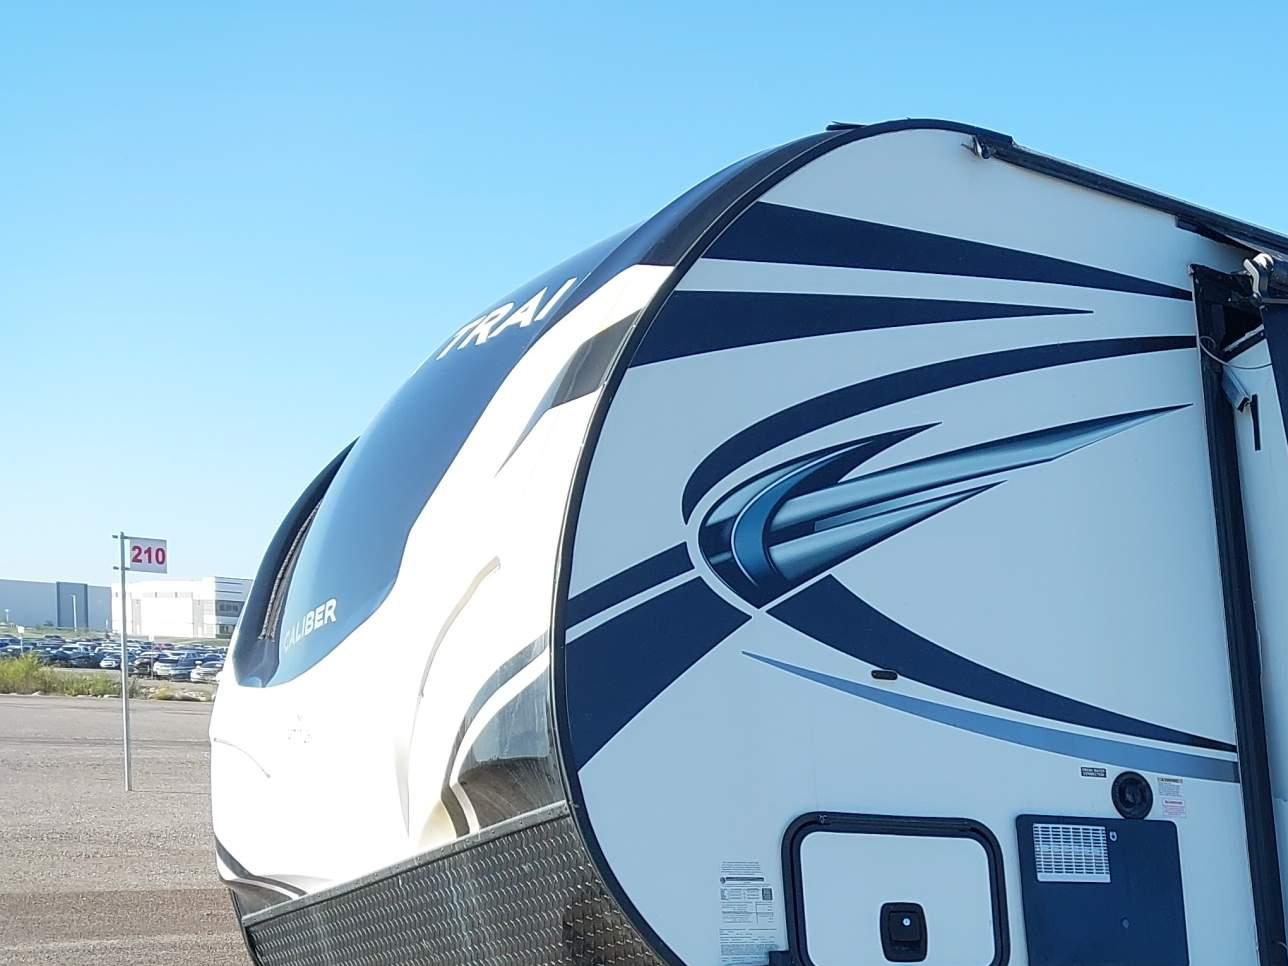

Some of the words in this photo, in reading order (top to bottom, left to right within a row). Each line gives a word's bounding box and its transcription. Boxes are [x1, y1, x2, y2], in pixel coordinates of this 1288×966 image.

[436, 276, 577, 361] TRAI
[131, 545, 166, 565] 210
[284, 598, 337, 652] CALIBER
